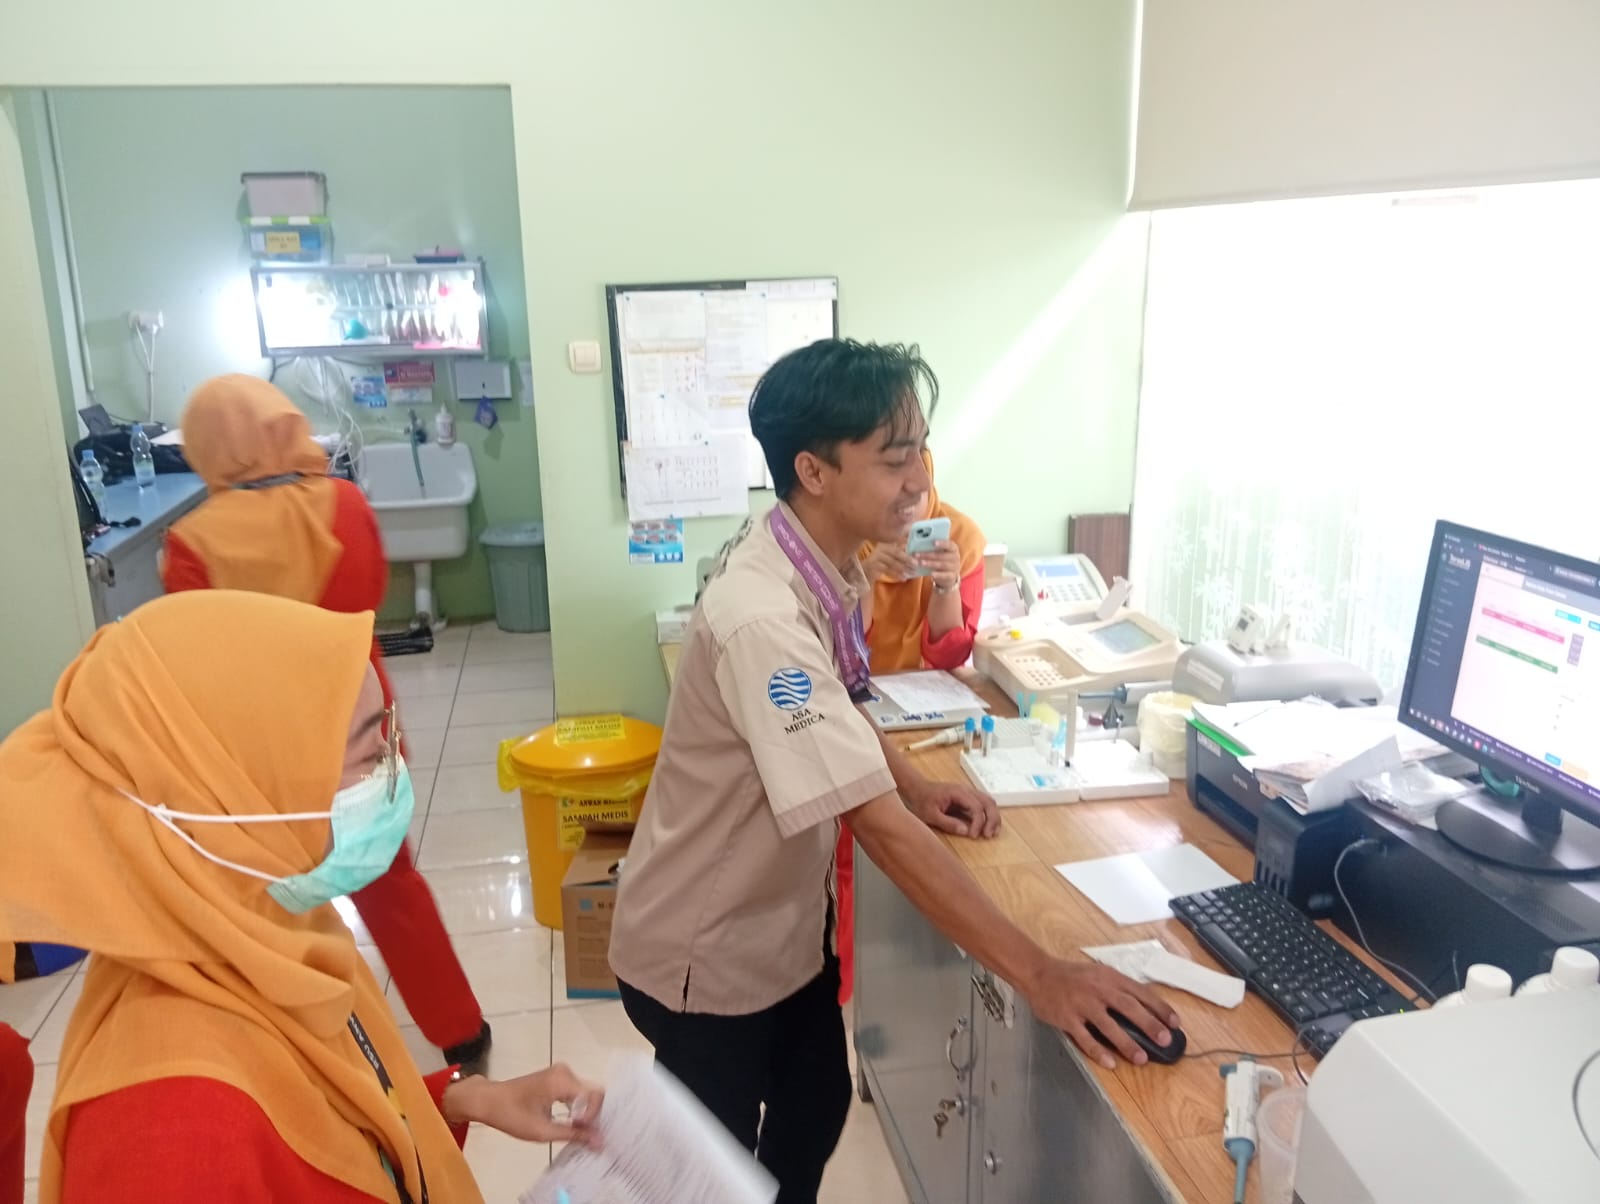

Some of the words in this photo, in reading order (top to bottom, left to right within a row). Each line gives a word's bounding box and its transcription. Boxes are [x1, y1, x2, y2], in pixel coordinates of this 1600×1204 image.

[792, 708, 811, 722] ASA
[784, 713, 825, 735] MEDICA
[563, 812, 599, 823] SAMPAH
[601, 810, 628, 821] MEDIS
